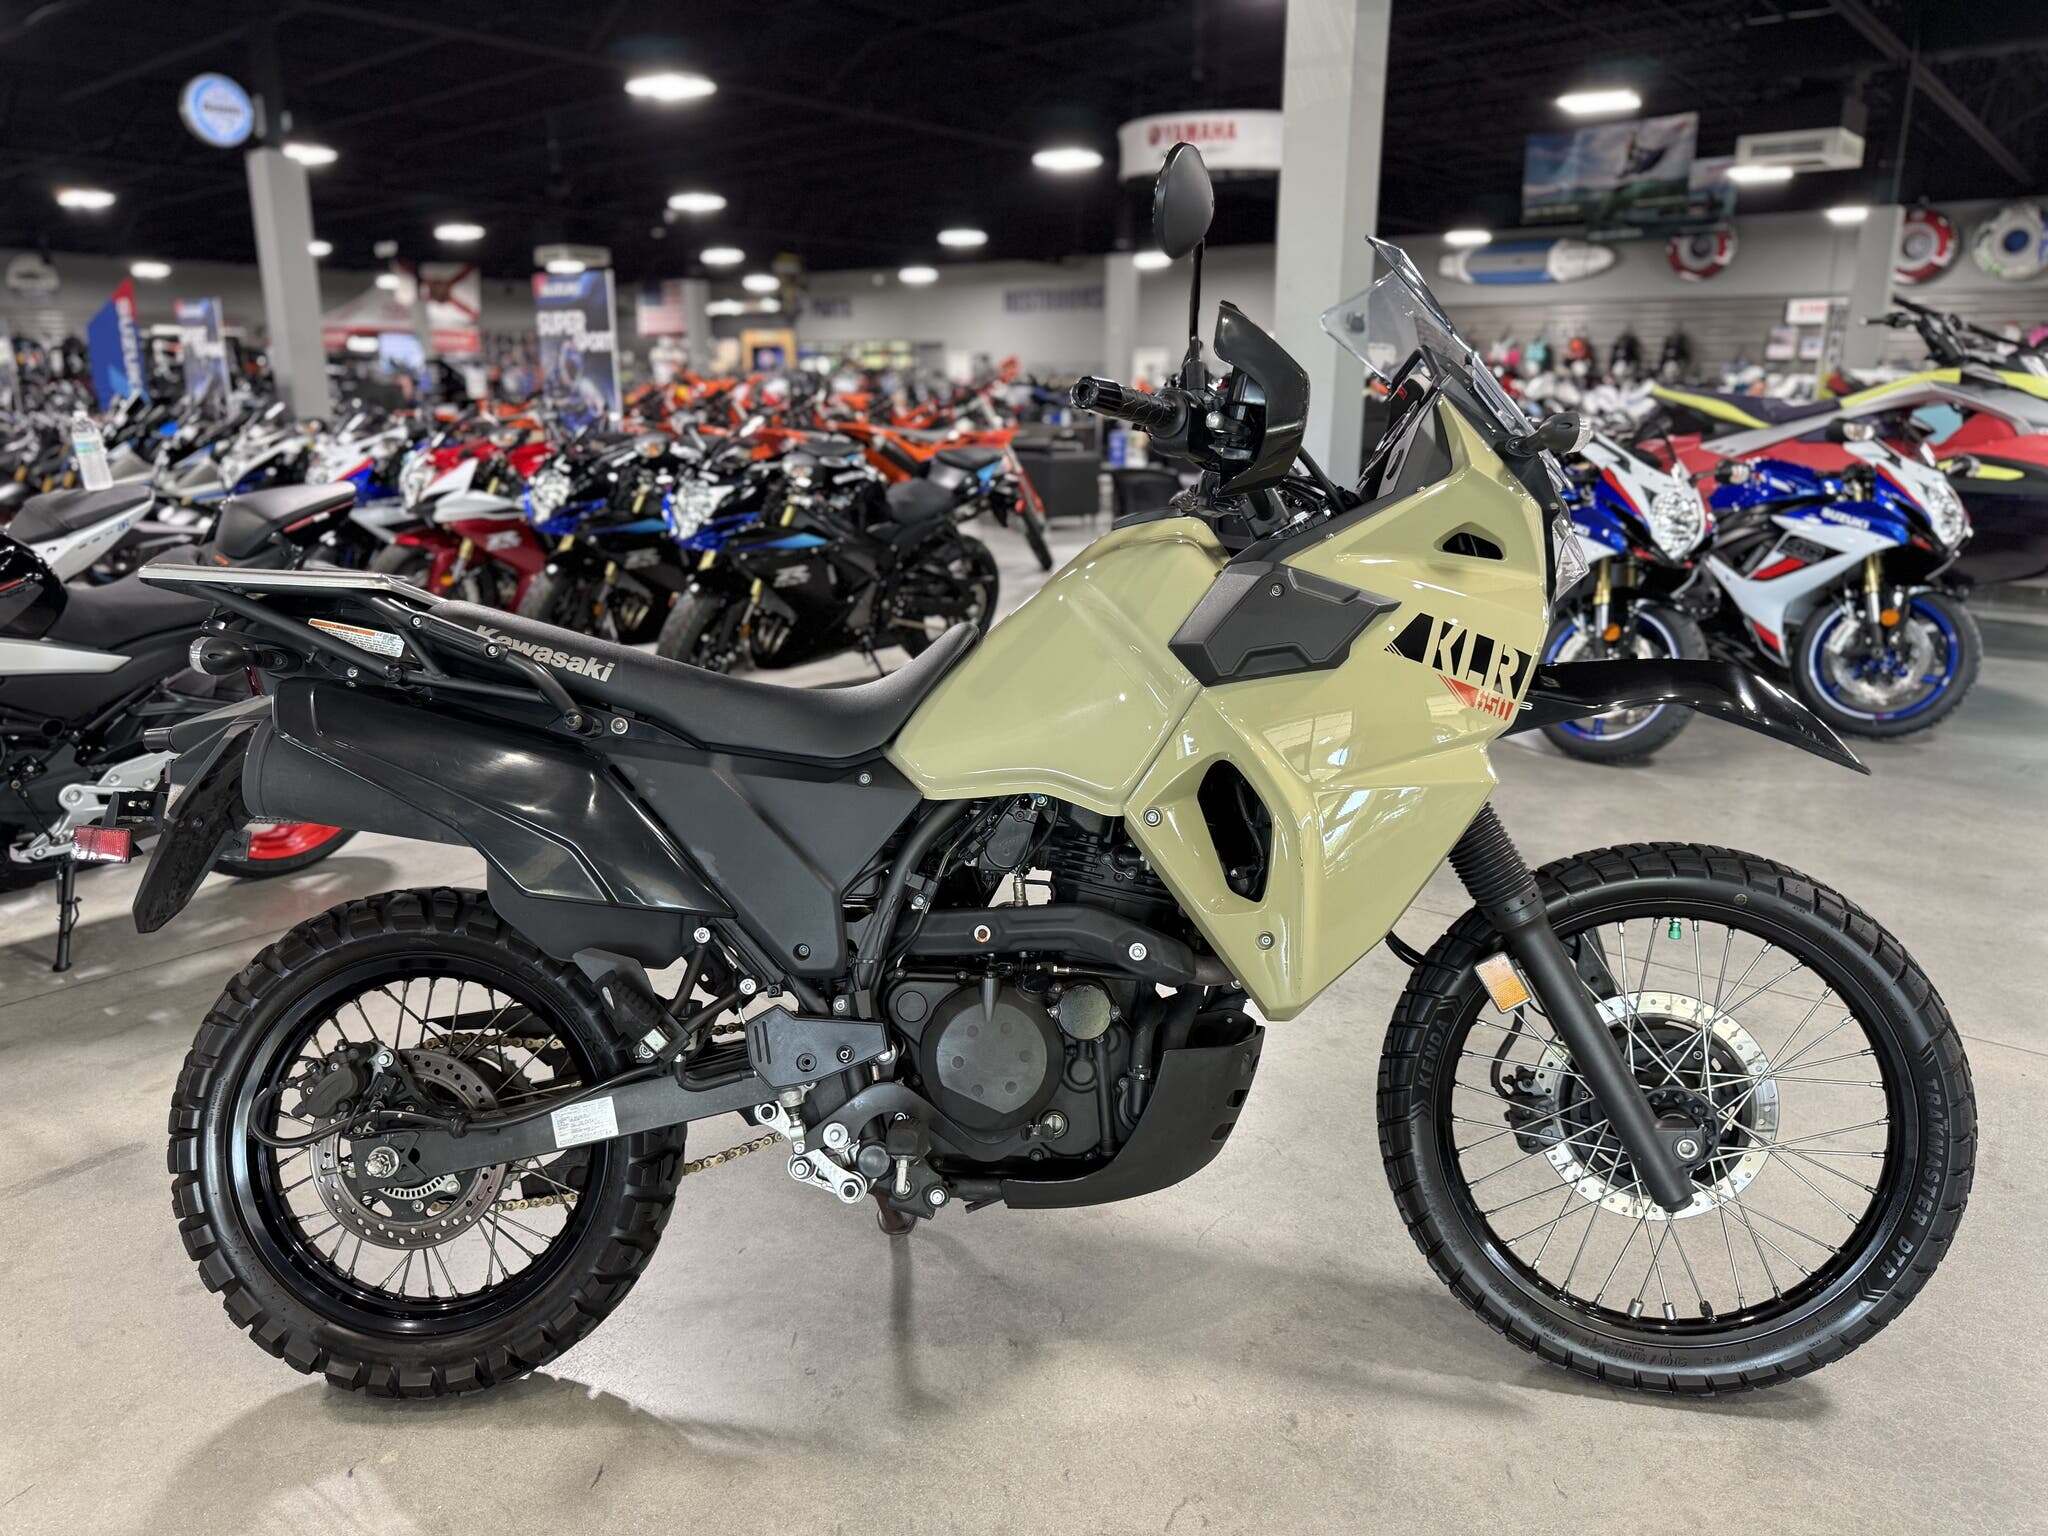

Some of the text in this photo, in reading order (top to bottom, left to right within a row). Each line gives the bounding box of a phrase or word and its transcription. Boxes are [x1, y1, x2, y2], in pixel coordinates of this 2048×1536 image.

[1820, 506, 1870, 531] SUZUKI
[476, 625, 616, 683] Kawasaki
[1422, 616, 1520, 700] KLR
[1418, 1019, 1452, 1089] KENDA
[1879, 1078, 1946, 1280] TRAKMASTER DTR
